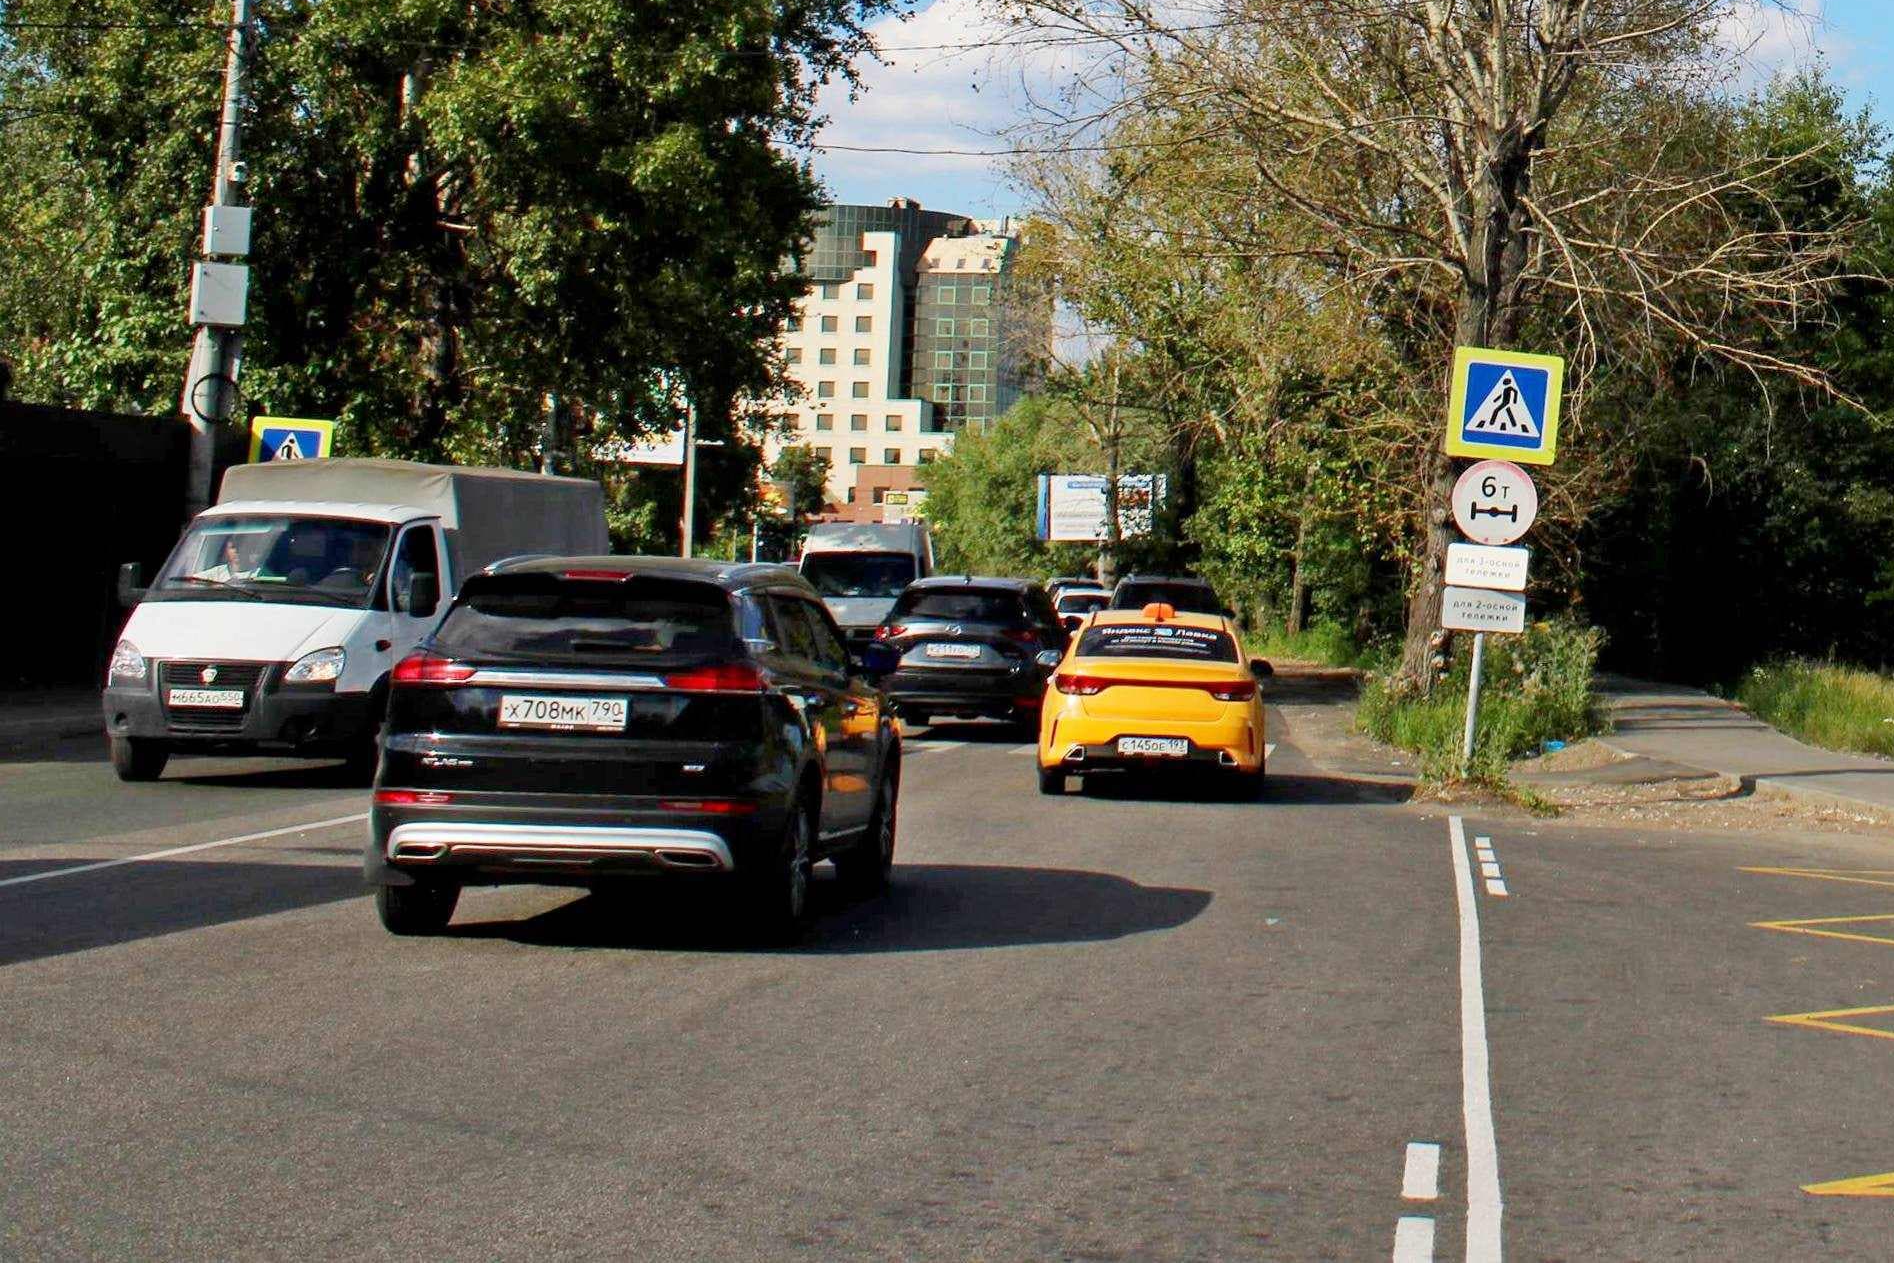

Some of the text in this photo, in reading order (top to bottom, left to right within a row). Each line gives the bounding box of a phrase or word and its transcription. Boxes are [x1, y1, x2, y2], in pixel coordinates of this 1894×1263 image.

[1453, 600, 1518, 612] для 2-осной
[1462, 612, 1508, 622] тележки
